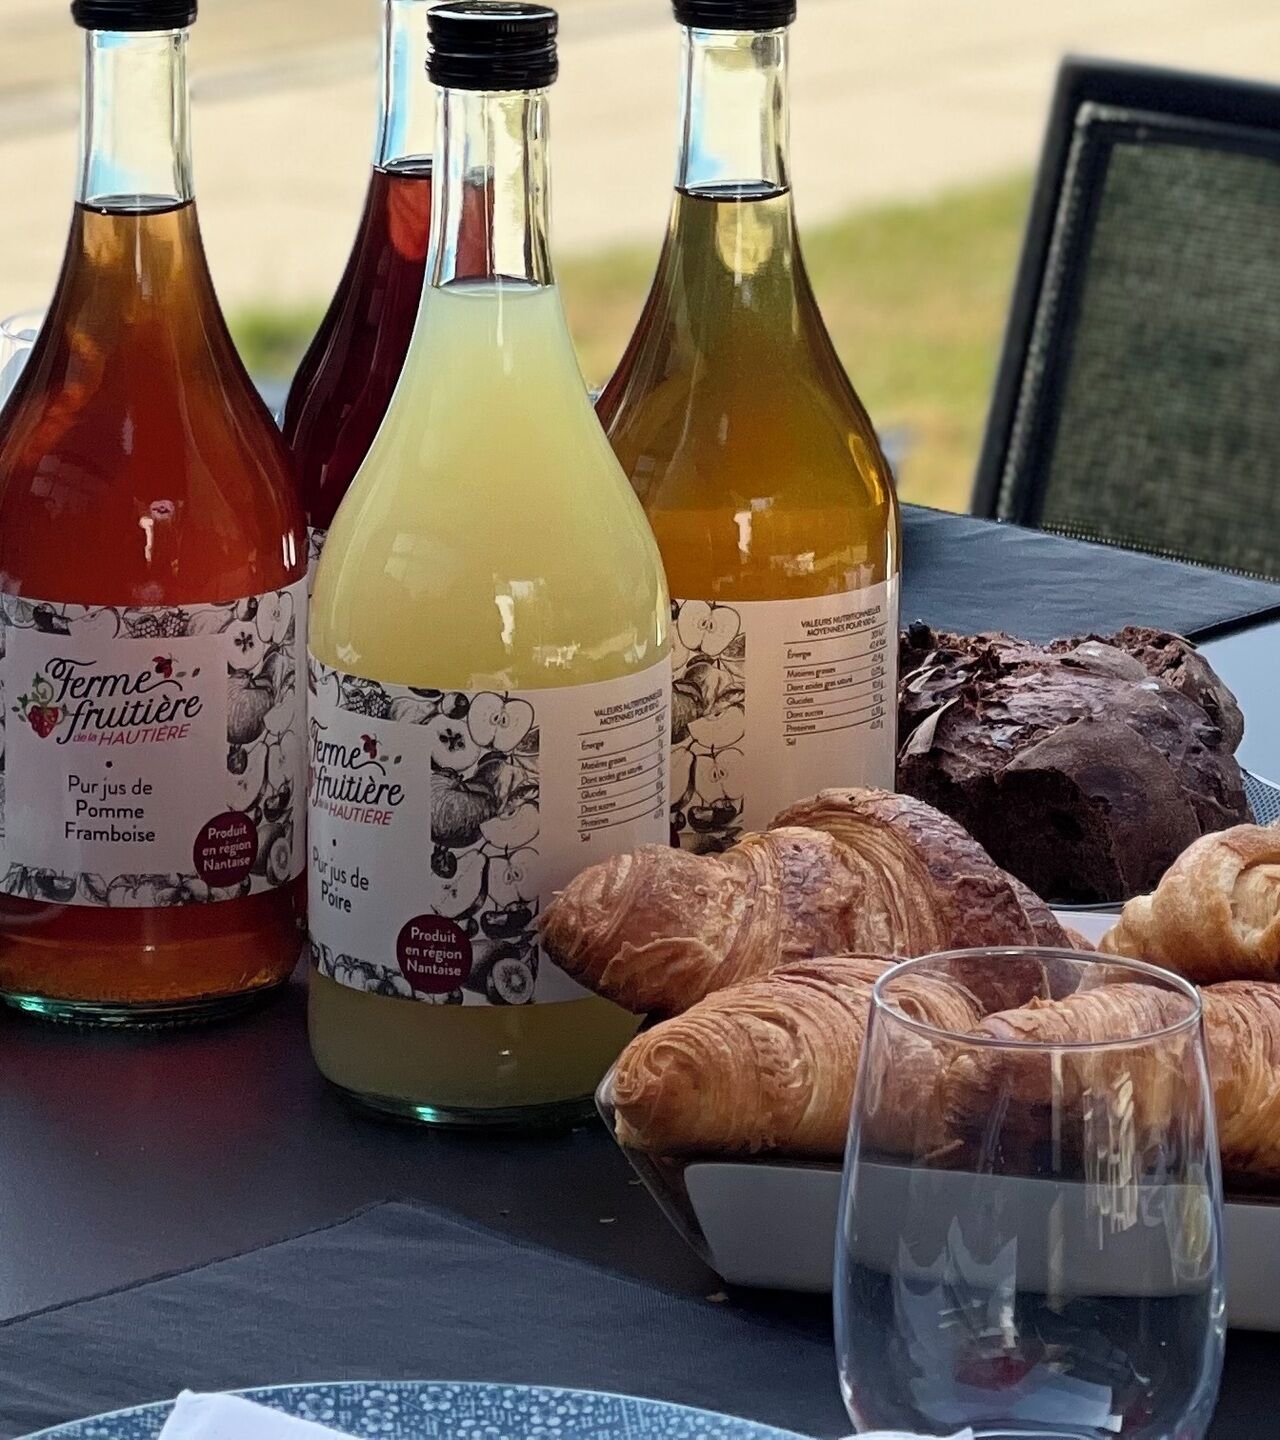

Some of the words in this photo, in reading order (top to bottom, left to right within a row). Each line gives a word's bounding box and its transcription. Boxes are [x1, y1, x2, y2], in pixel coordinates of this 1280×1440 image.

[801, 617, 832, 628] VALEURS
[806, 624, 845, 636] MOYENNES
[845, 620, 862, 631] POUR
[45, 657, 182, 702] Ferme
[787, 682, 804, 692] Dont
[56, 692, 202, 744] fruitière
[786, 709, 804, 719] Dont
[99, 723, 192, 746] HAUTIÈRE
[310, 716, 386, 776] Ferme
[68, 775, 99, 794] Pur
[100, 777, 126, 803] jus
[131, 778, 153, 796] de
[312, 765, 405, 807] fruitière
[75, 800, 145, 819] Pomme
[328, 802, 395, 825] HAUTIÈRE
[64, 822, 156, 842] Framboise
[208, 825, 247, 840] Produit
[202, 845, 218, 856] en
[219, 839, 252, 858] région
[203, 855, 251, 873] Nantaise
[312, 849, 328, 877] Pur
[328, 857, 347, 888] jus
[350, 866, 369, 891] de
[321, 885, 352, 914] Poire
[410, 927, 456, 944] Produit
[405, 946, 421, 957] en
[423, 943, 462, 964] région
[406, 959, 462, 977] Nantaise
